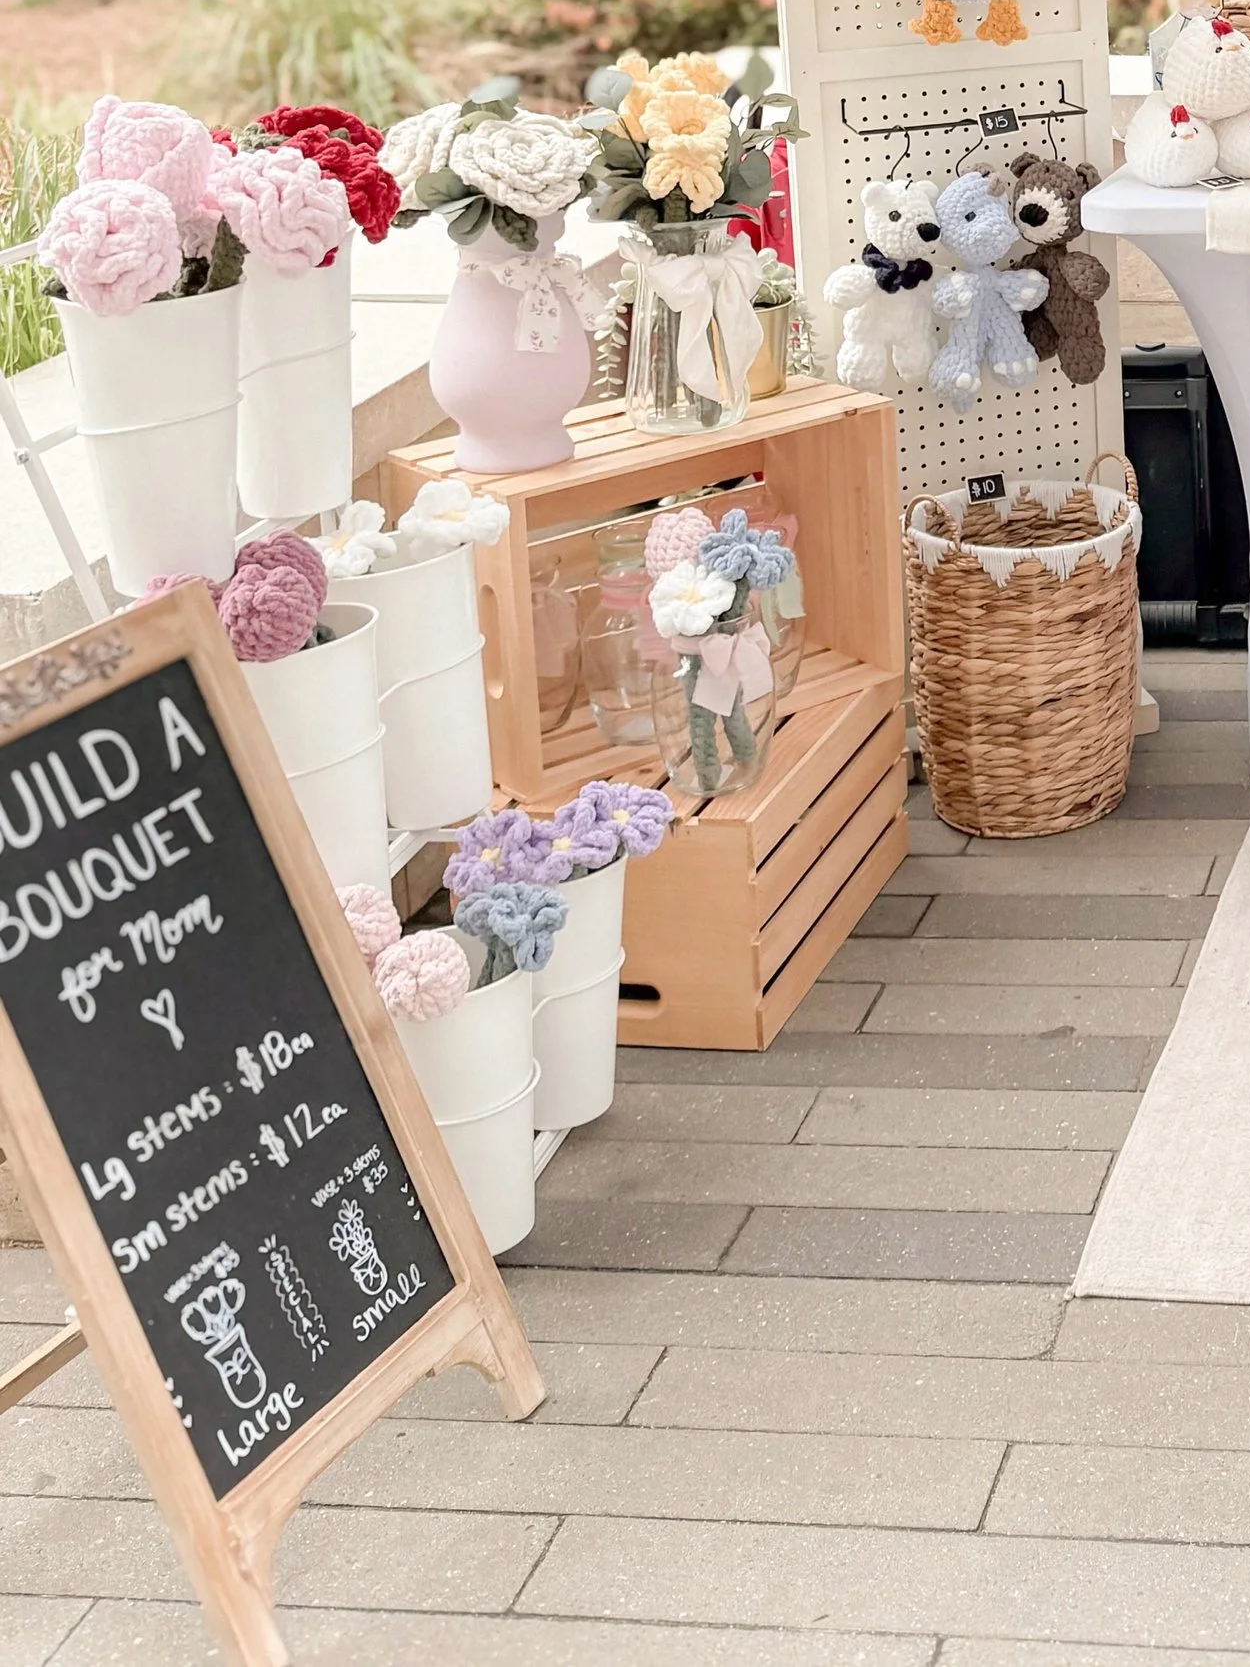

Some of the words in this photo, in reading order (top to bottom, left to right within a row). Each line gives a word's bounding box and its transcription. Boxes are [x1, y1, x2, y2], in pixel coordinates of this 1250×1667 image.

[986, 115, 1009, 130] $15
[972, 479, 996, 498] $10
[0, 729, 140, 856] UILD
[158, 696, 206, 773] A
[58, 946, 124, 1023] for
